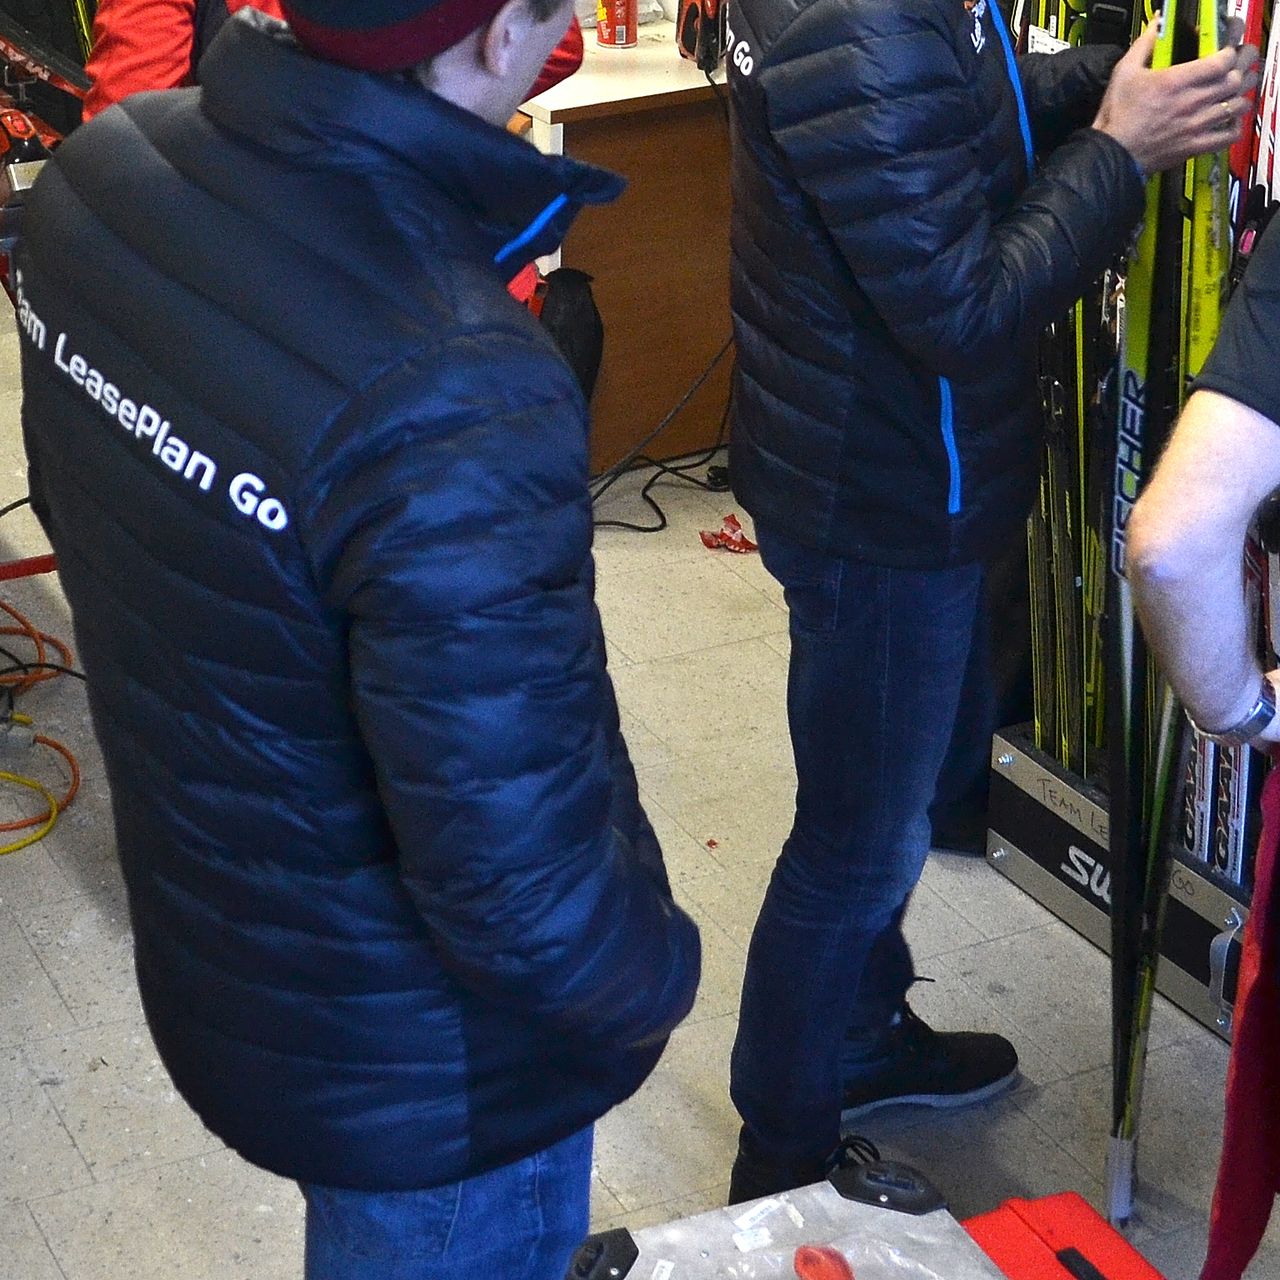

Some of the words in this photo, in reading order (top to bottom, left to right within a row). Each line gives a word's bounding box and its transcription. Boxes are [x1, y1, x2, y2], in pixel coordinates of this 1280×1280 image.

[732, 38, 754, 78] Go
[53, 331, 220, 492] LeasePlan
[228, 470, 291, 532] Go
[1036, 778, 1083, 824] TEAM
